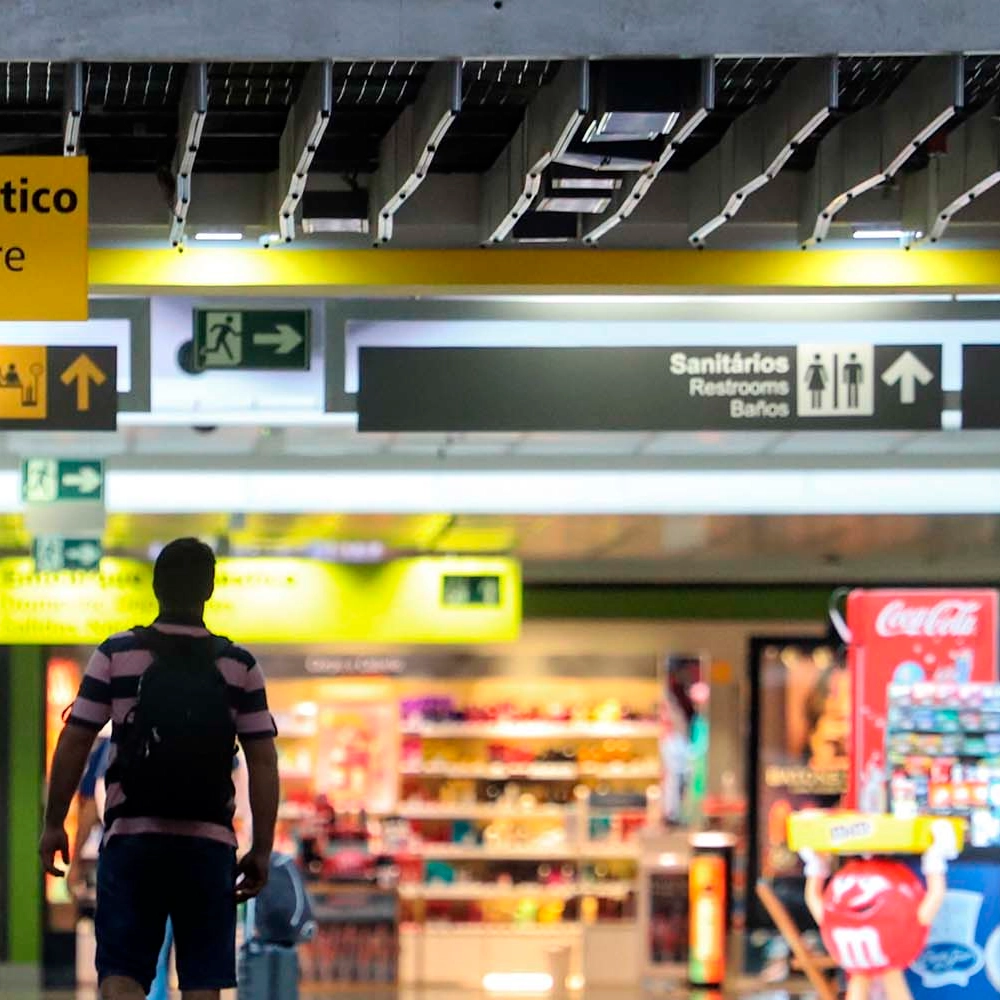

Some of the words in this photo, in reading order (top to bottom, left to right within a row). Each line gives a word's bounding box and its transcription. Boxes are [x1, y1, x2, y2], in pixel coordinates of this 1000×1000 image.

[669, 351, 790, 375] Sanitários
[689, 377, 790, 396] Restrooms
[729, 399, 790, 418] Baños
